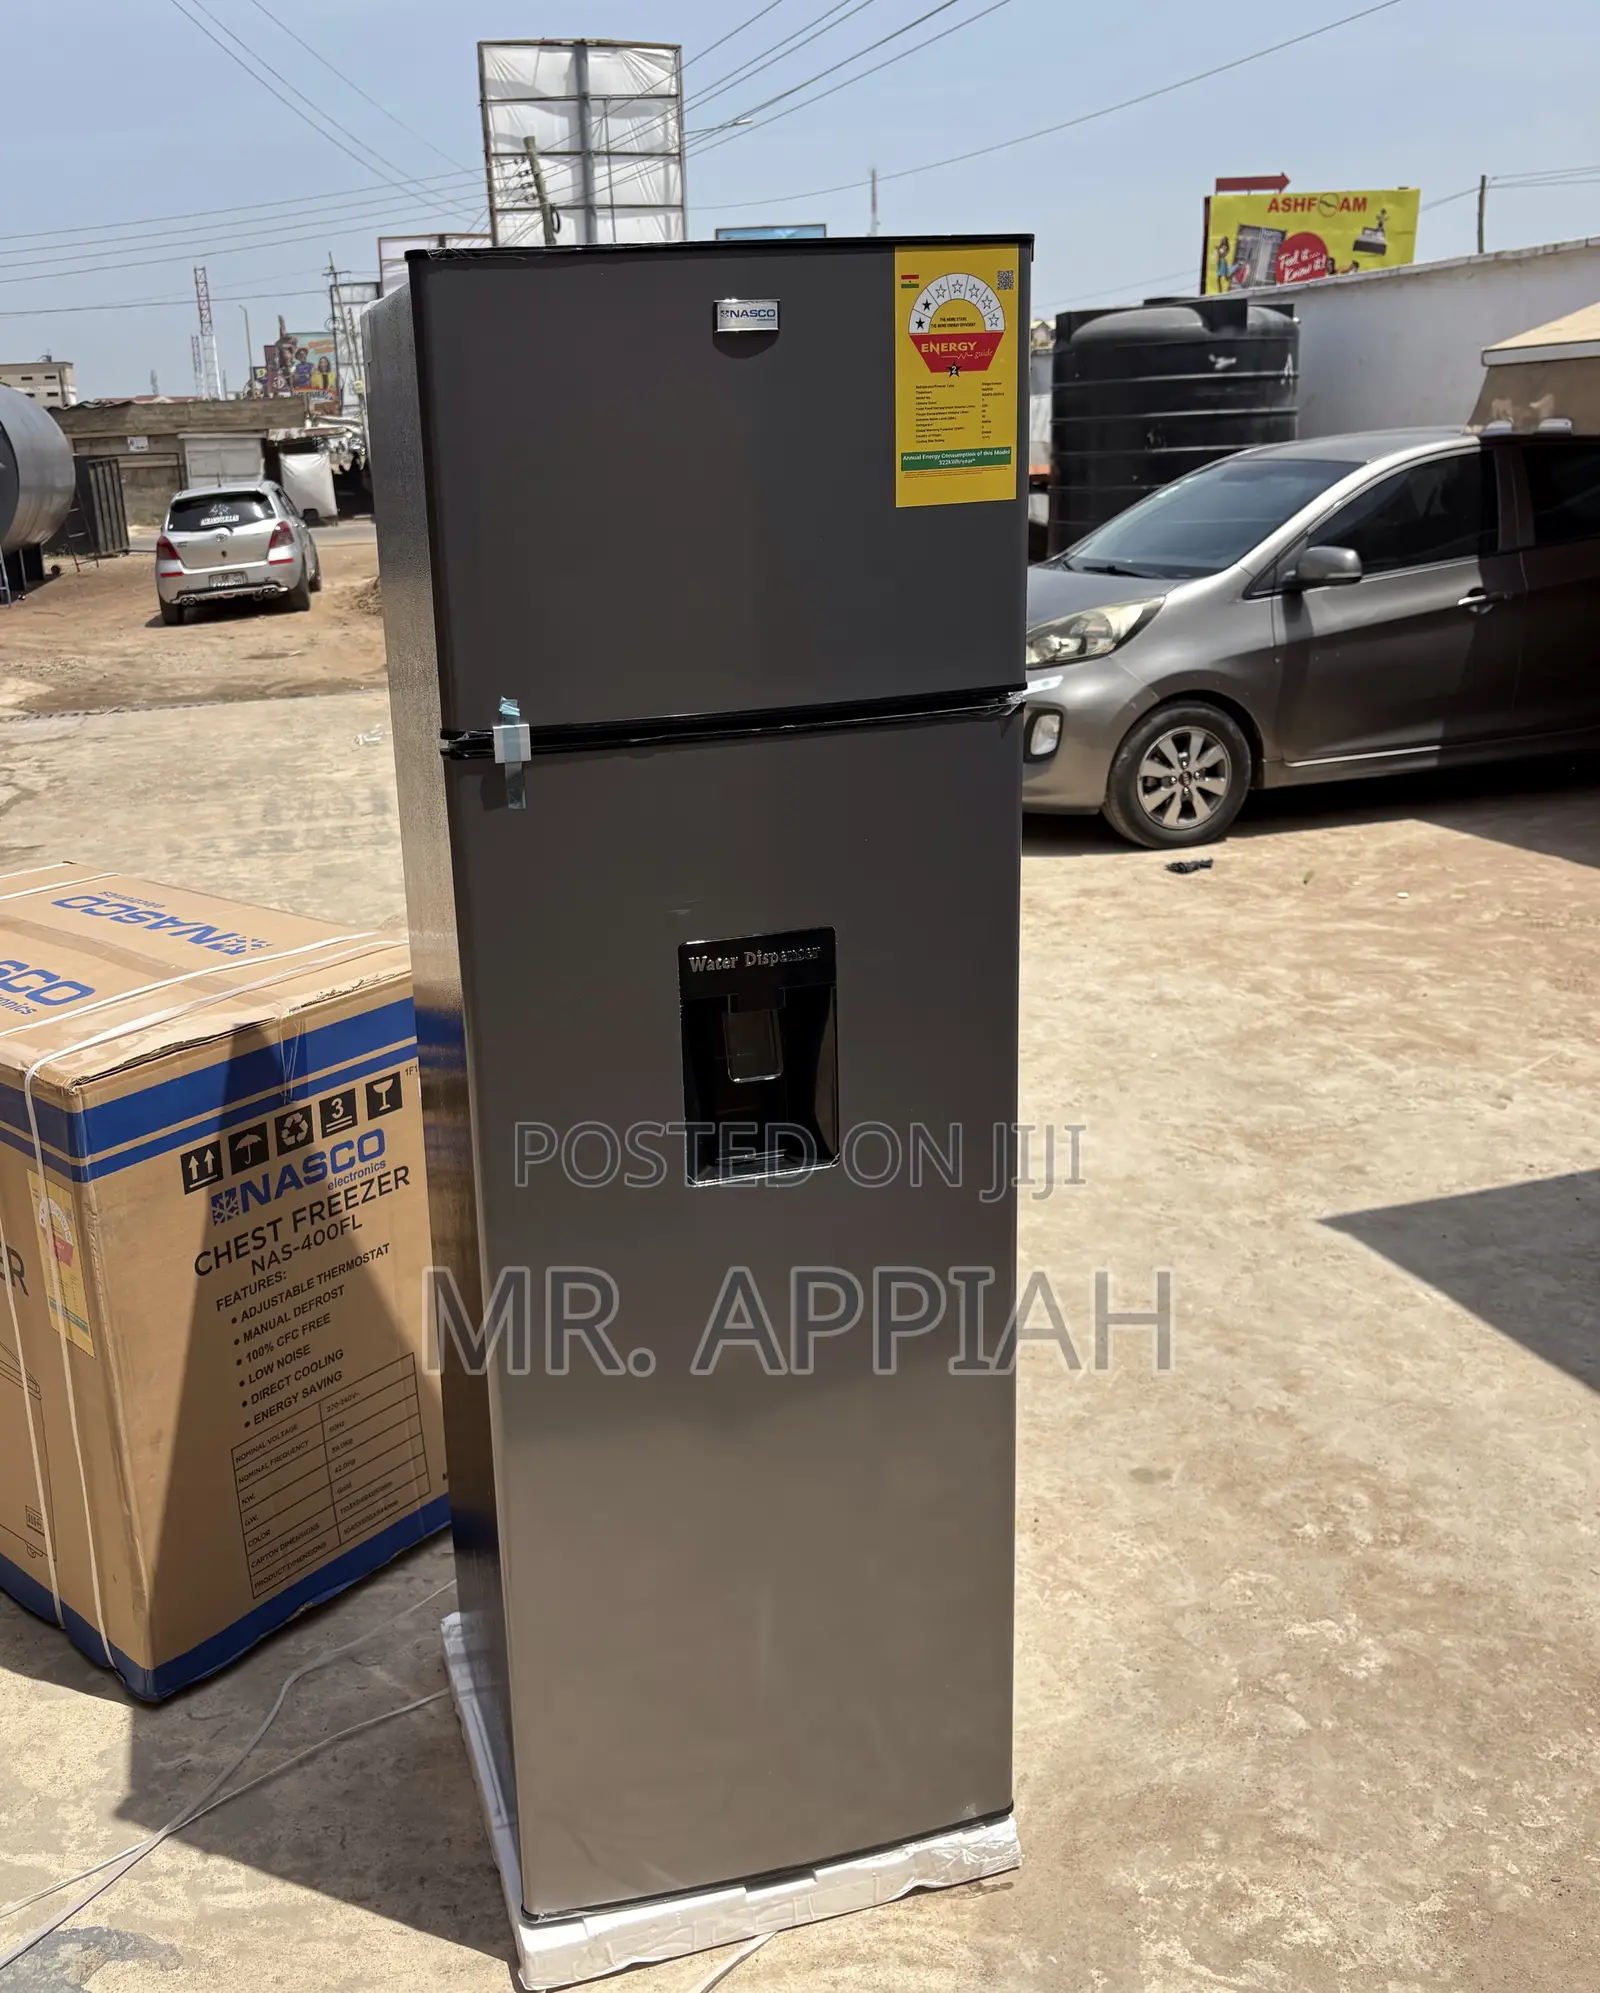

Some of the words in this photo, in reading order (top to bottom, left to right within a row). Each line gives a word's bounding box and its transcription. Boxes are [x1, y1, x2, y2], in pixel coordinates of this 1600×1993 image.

[730, 308, 776, 318] NASCO
[921, 341, 977, 355] ENERGY
[974, 348, 993, 359] guide
[922, 453, 941, 461] Energy
[941, 451, 976, 459] Consumption
[51, 895, 237, 951] NASCO
[688, 955, 738, 973] Water
[744, 946, 821, 967] Dispenser
[240, 1128, 386, 1214] NASCO
[327, 1160, 387, 1191] electronics
[194, 1217, 283, 1276] CHEST
[292, 1165, 411, 1234] FREEZER
[251, 1214, 363, 1276] NAS-400FL
[216, 1271, 287, 1312] FEATURES:
[241, 1278, 315, 1323] ADJUSTABLE
[316, 1243, 391, 1285] THERMOSTAT
[243, 1312, 292, 1343] MANUAL
[293, 1284, 346, 1319] DEFROST
[246, 1343, 275, 1363] 100%
[276, 1327, 300, 1348] CFC
[301, 1313, 331, 1336] FREE
[248, 1365, 274, 1385] LOW
[277, 1344, 312, 1368] NOISE
[251, 1374, 293, 1406] DIRECT
[294, 1349, 345, 1382] COOLING
[254, 1392, 300, 1426] ENERGY
[301, 1370, 343, 1399] SAVING
[235, 1442, 267, 1463] NOMINAL
[267, 1423, 298, 1444] VOLTAGE
[239, 1462, 270, 1484] NOMINAL
[270, 1439, 310, 1466] FREQUENCY
[248, 1529, 271, 1548] COLOR
[251, 1548, 279, 1569] CARTON
[280, 1522, 320, 1551] DIMENSIONS
[254, 1565, 286, 1590] PRODUCT
[286, 1541, 327, 1570] DIMENSIONS
